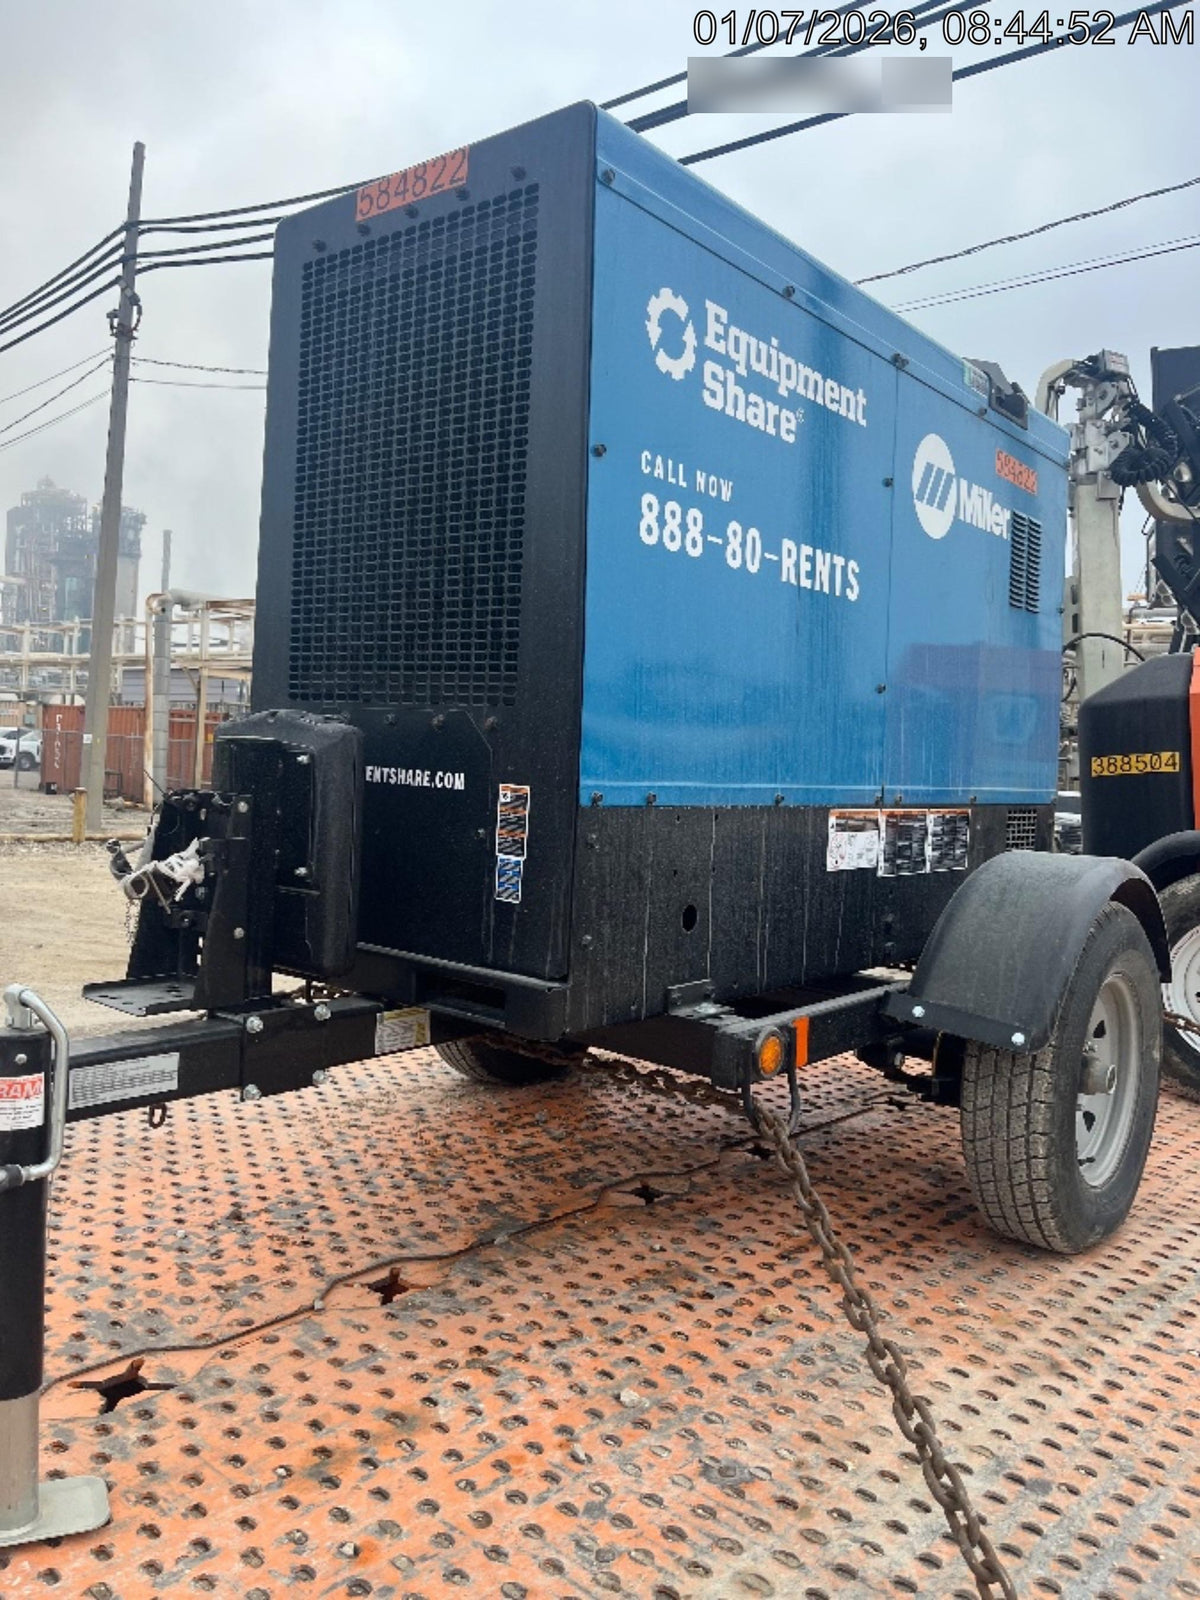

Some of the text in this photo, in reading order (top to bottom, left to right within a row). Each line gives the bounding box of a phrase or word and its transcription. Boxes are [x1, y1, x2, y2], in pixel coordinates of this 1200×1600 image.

[359, 147, 466, 216] 584822
[704, 299, 868, 428] Equipment
[641, 450, 733, 502] CALL NOW
[959, 477, 1011, 540] Miller
[639, 492, 860, 601] 888-80-RENTS
[365, 765, 465, 790] ENTSHARE.COM
